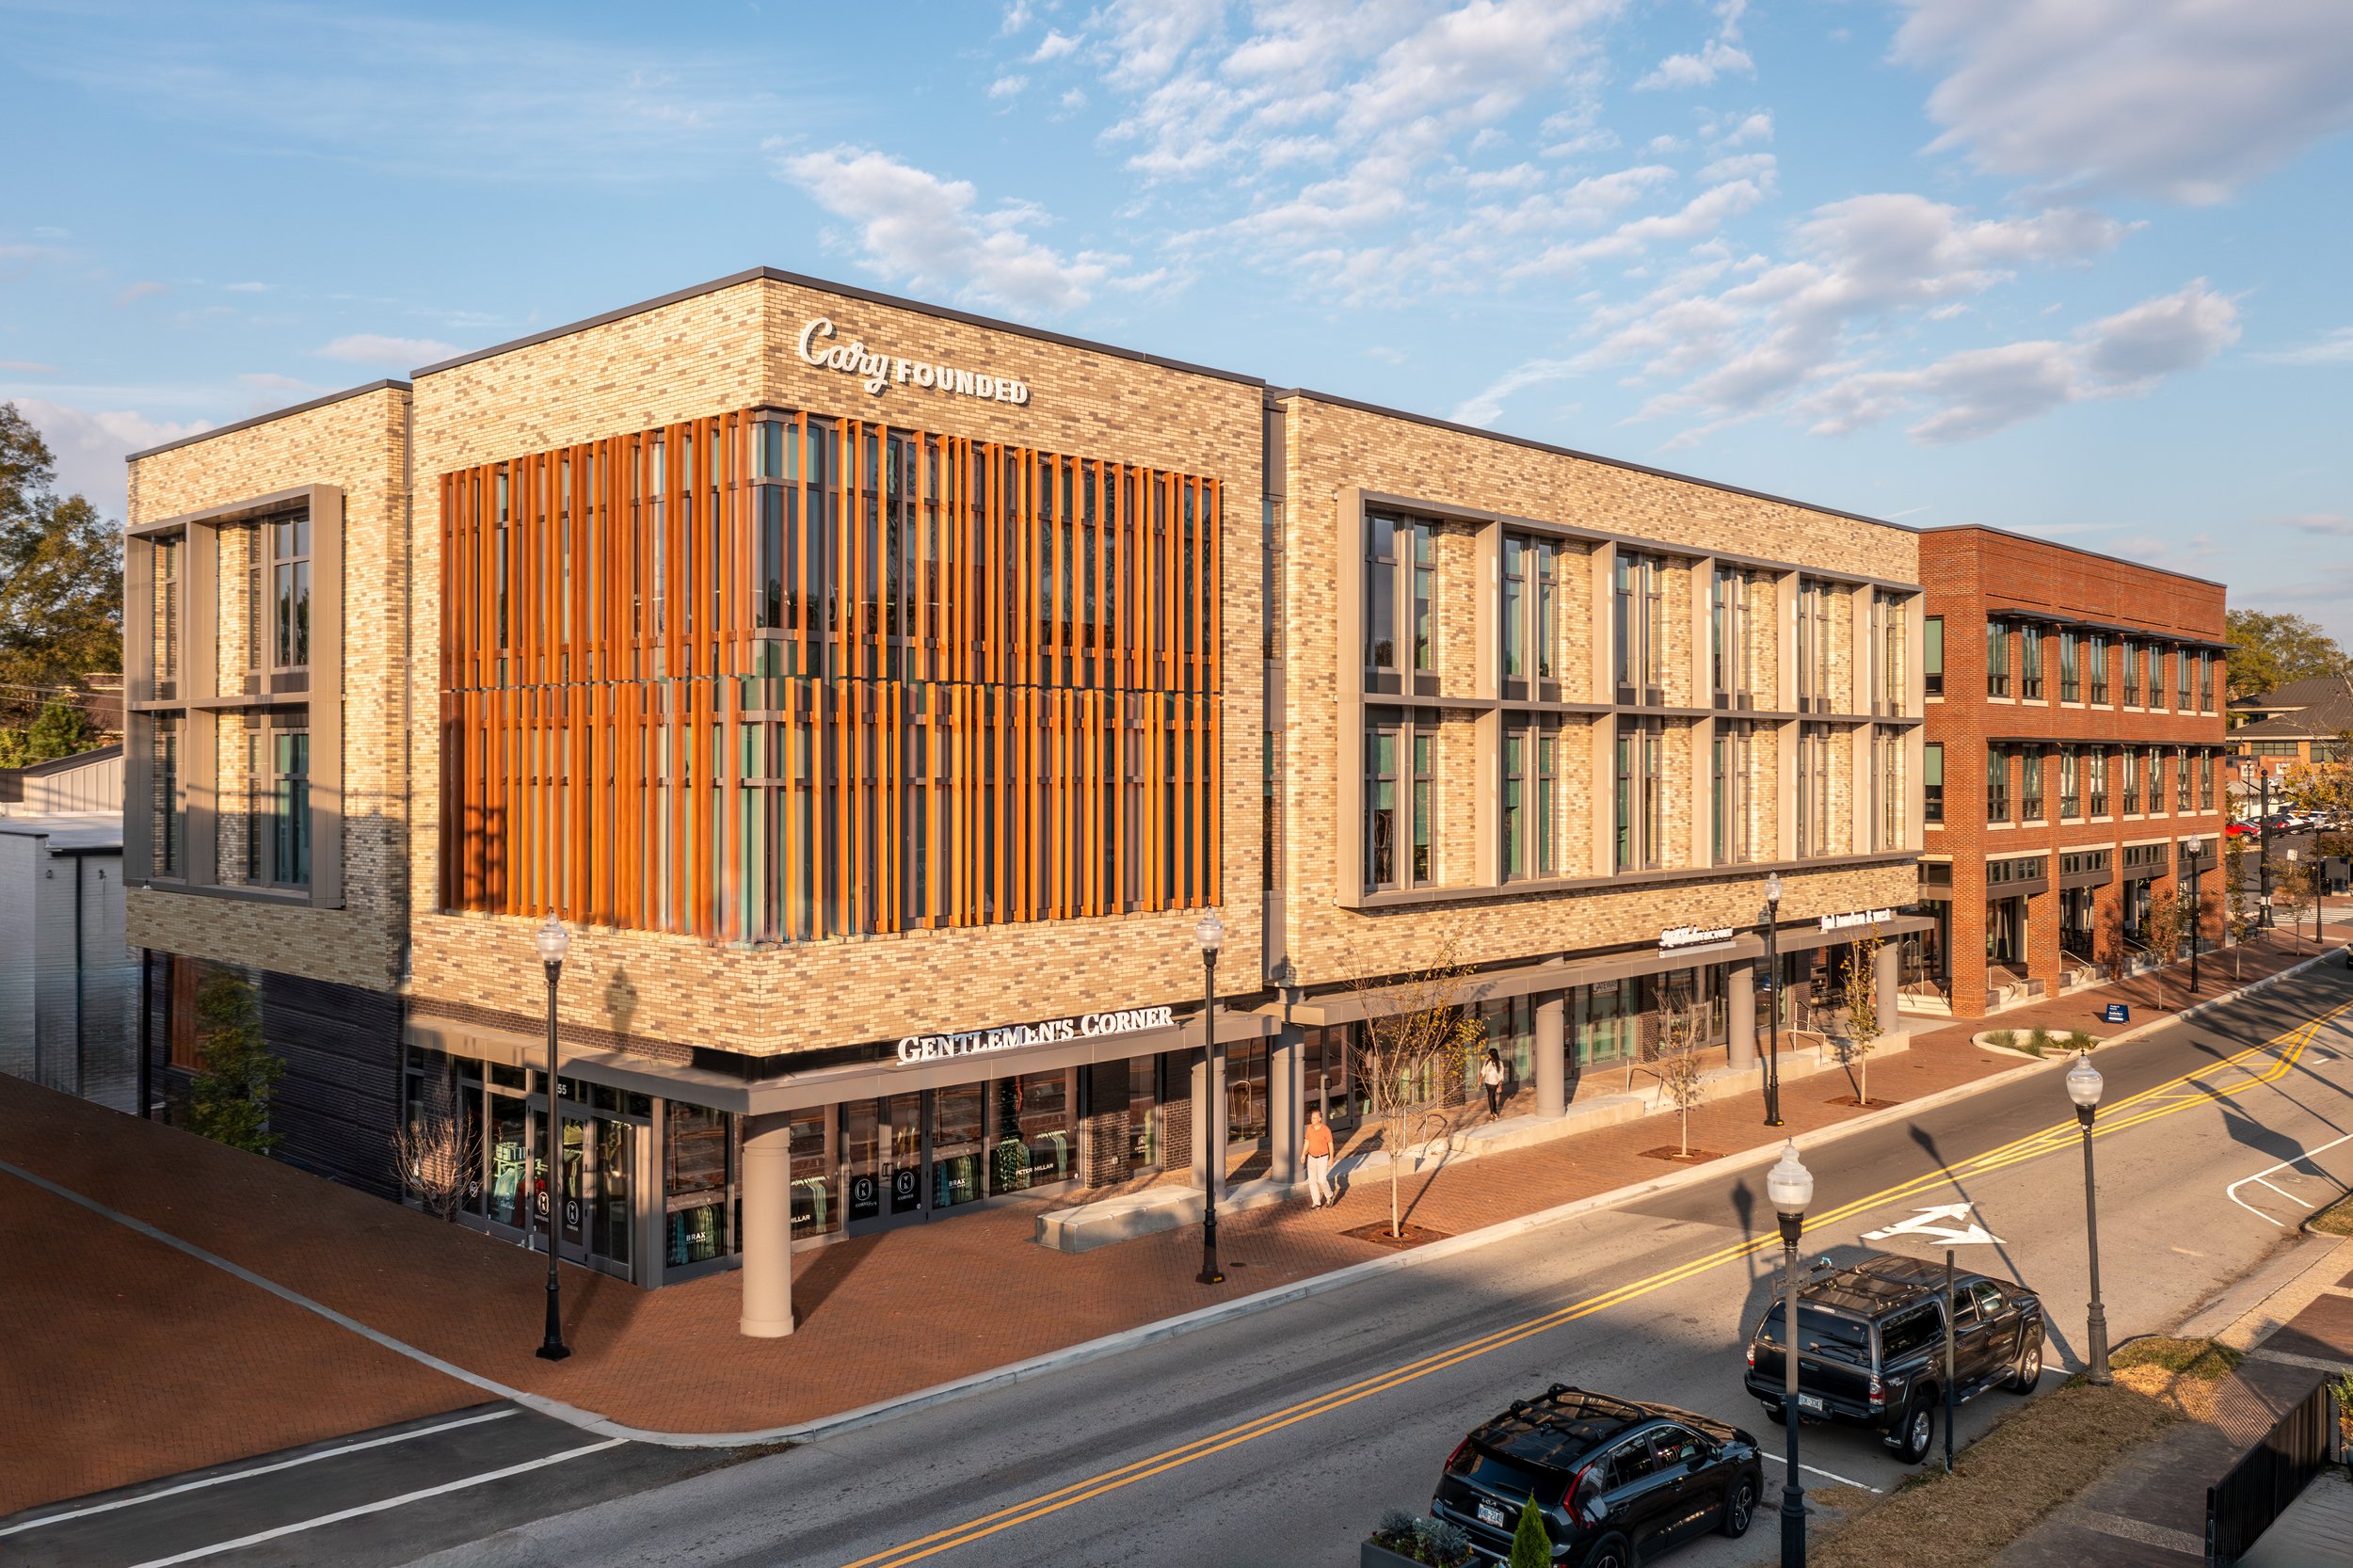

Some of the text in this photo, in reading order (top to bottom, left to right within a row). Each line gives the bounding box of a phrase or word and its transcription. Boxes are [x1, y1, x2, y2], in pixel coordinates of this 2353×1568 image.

[798, 316, 1028, 405] Cary FOUNDED
[897, 1005, 1175, 1064] GENTLEMEN'S CORNER
[1016, 1162, 1054, 1176] PETER MILLAR
[948, 1178, 966, 1187] BRAX
[686, 1231, 706, 1241] BRAX
